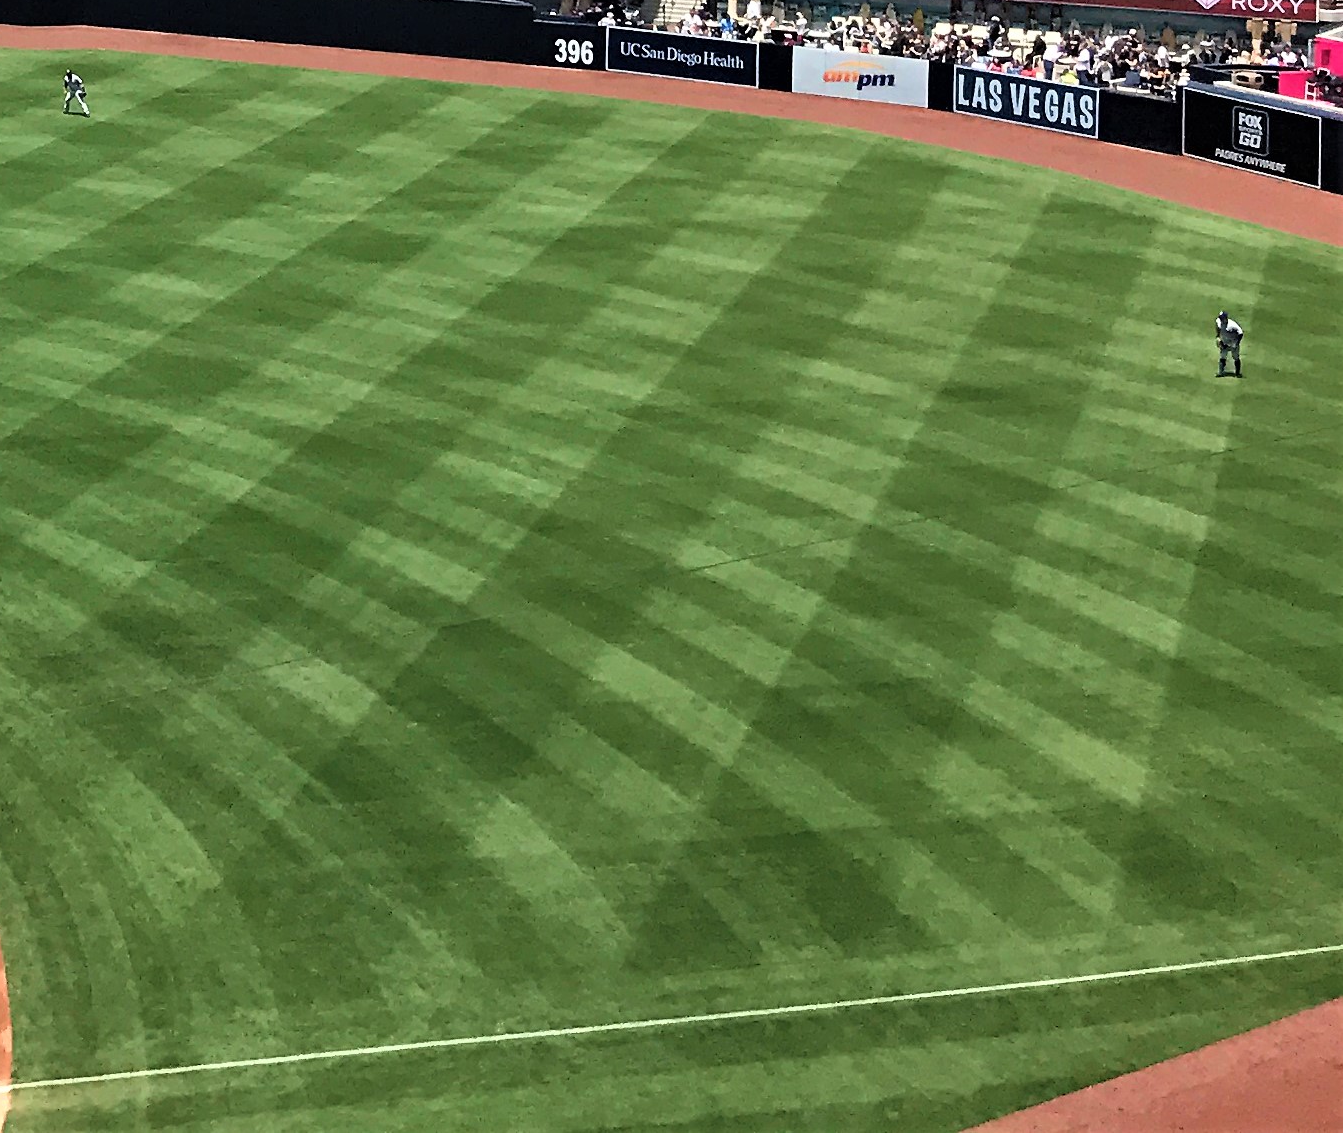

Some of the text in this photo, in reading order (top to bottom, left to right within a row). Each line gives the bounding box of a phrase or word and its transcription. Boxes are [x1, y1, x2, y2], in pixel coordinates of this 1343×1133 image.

[554, 38, 595, 65] 396
[620, 41, 744, 70] UC San Diego Health
[958, 73, 1094, 130] LAS VEGAS
[1238, 111, 1263, 131] FOX
[1238, 132, 1262, 149] GO
[1215, 148, 1245, 164] PADRES
